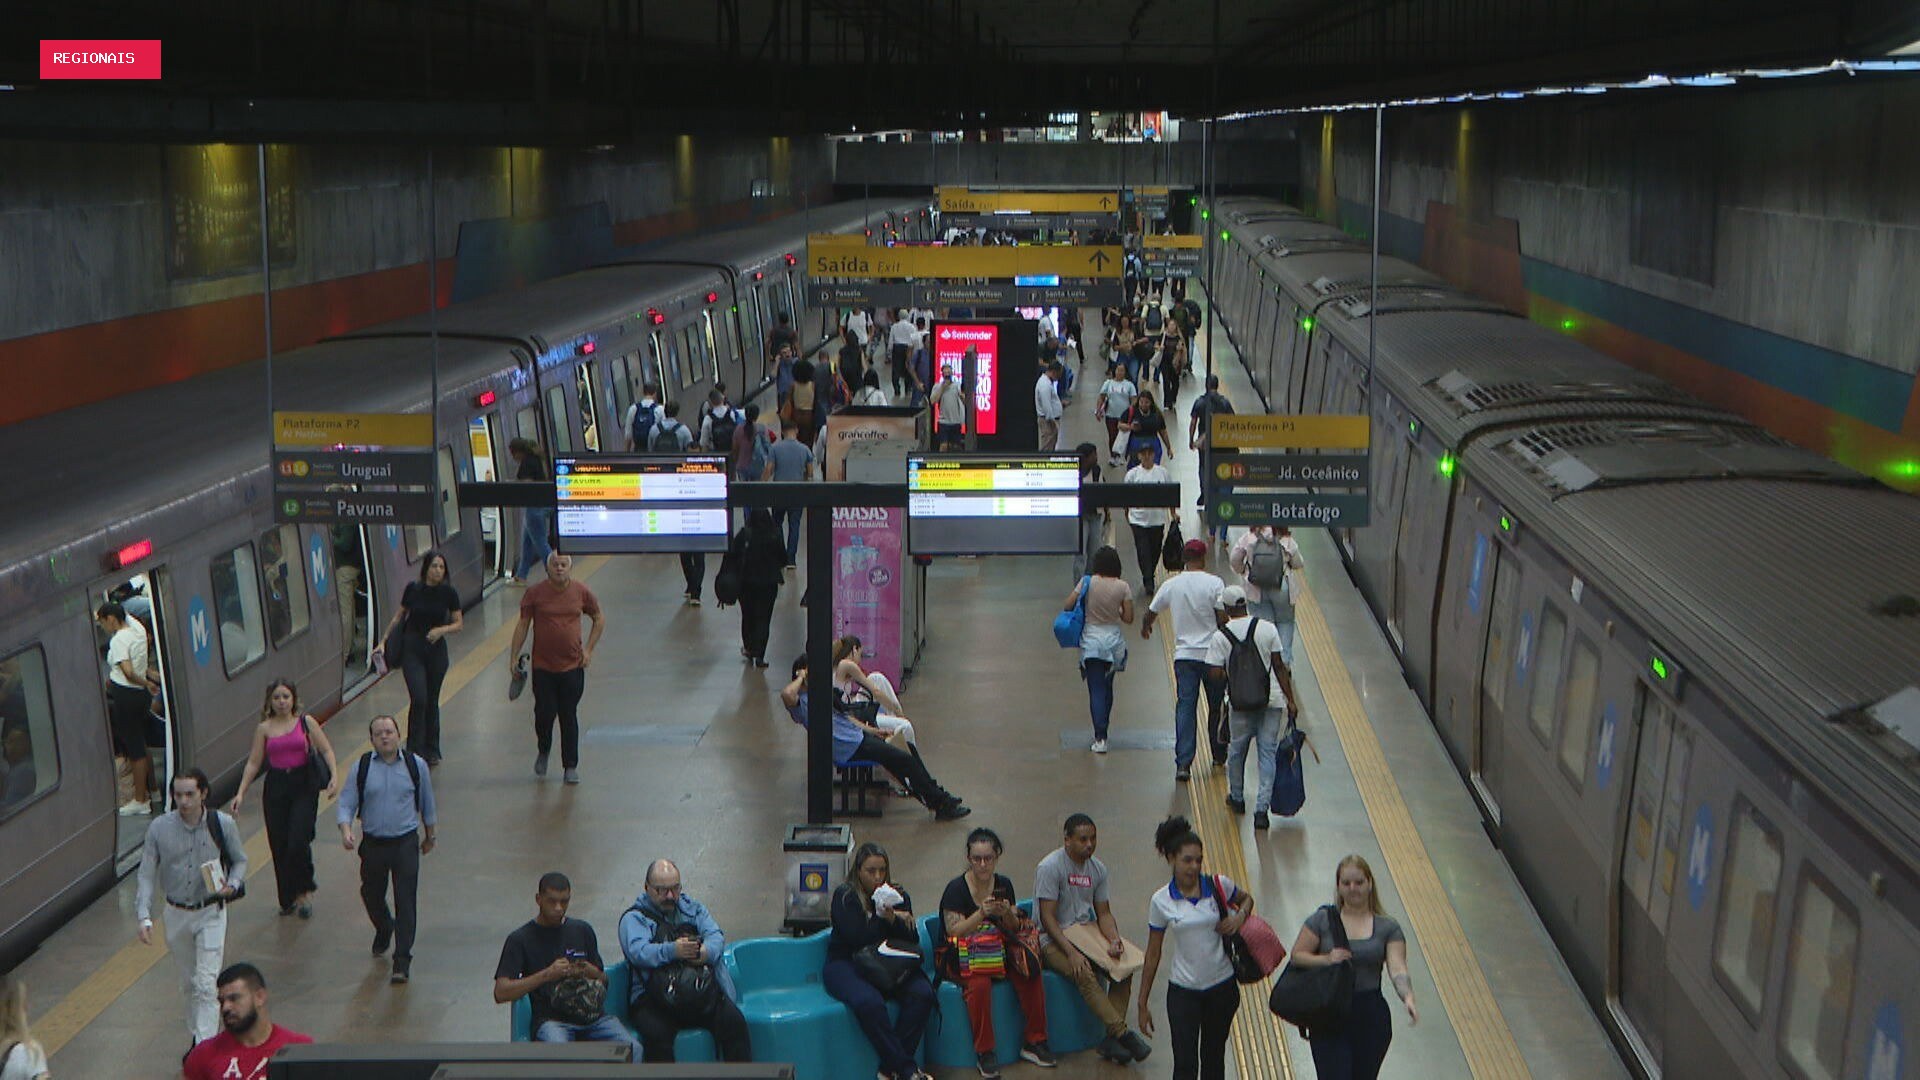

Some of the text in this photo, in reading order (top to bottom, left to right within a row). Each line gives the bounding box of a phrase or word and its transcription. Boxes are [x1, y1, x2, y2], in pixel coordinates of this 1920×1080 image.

[945, 199, 975, 210] Saída
[817, 255, 901, 273] Saída Exit
[951, 329, 993, 340] Santander
[283, 419, 360, 430] Plataforma P2
[1220, 420, 1295, 432] Plataforma P1
[838, 429, 889, 441] grancoffee
[341, 463, 391, 480] Uruguai
[1278, 464, 1360, 480] Jd. Oceânico
[285, 501, 298, 513] L2
[337, 500, 394, 517] Pavuna
[1220, 504, 1232, 517] L2
[1271, 501, 1341, 523] Botafogo
[223, 1056, 243, 1079] A
